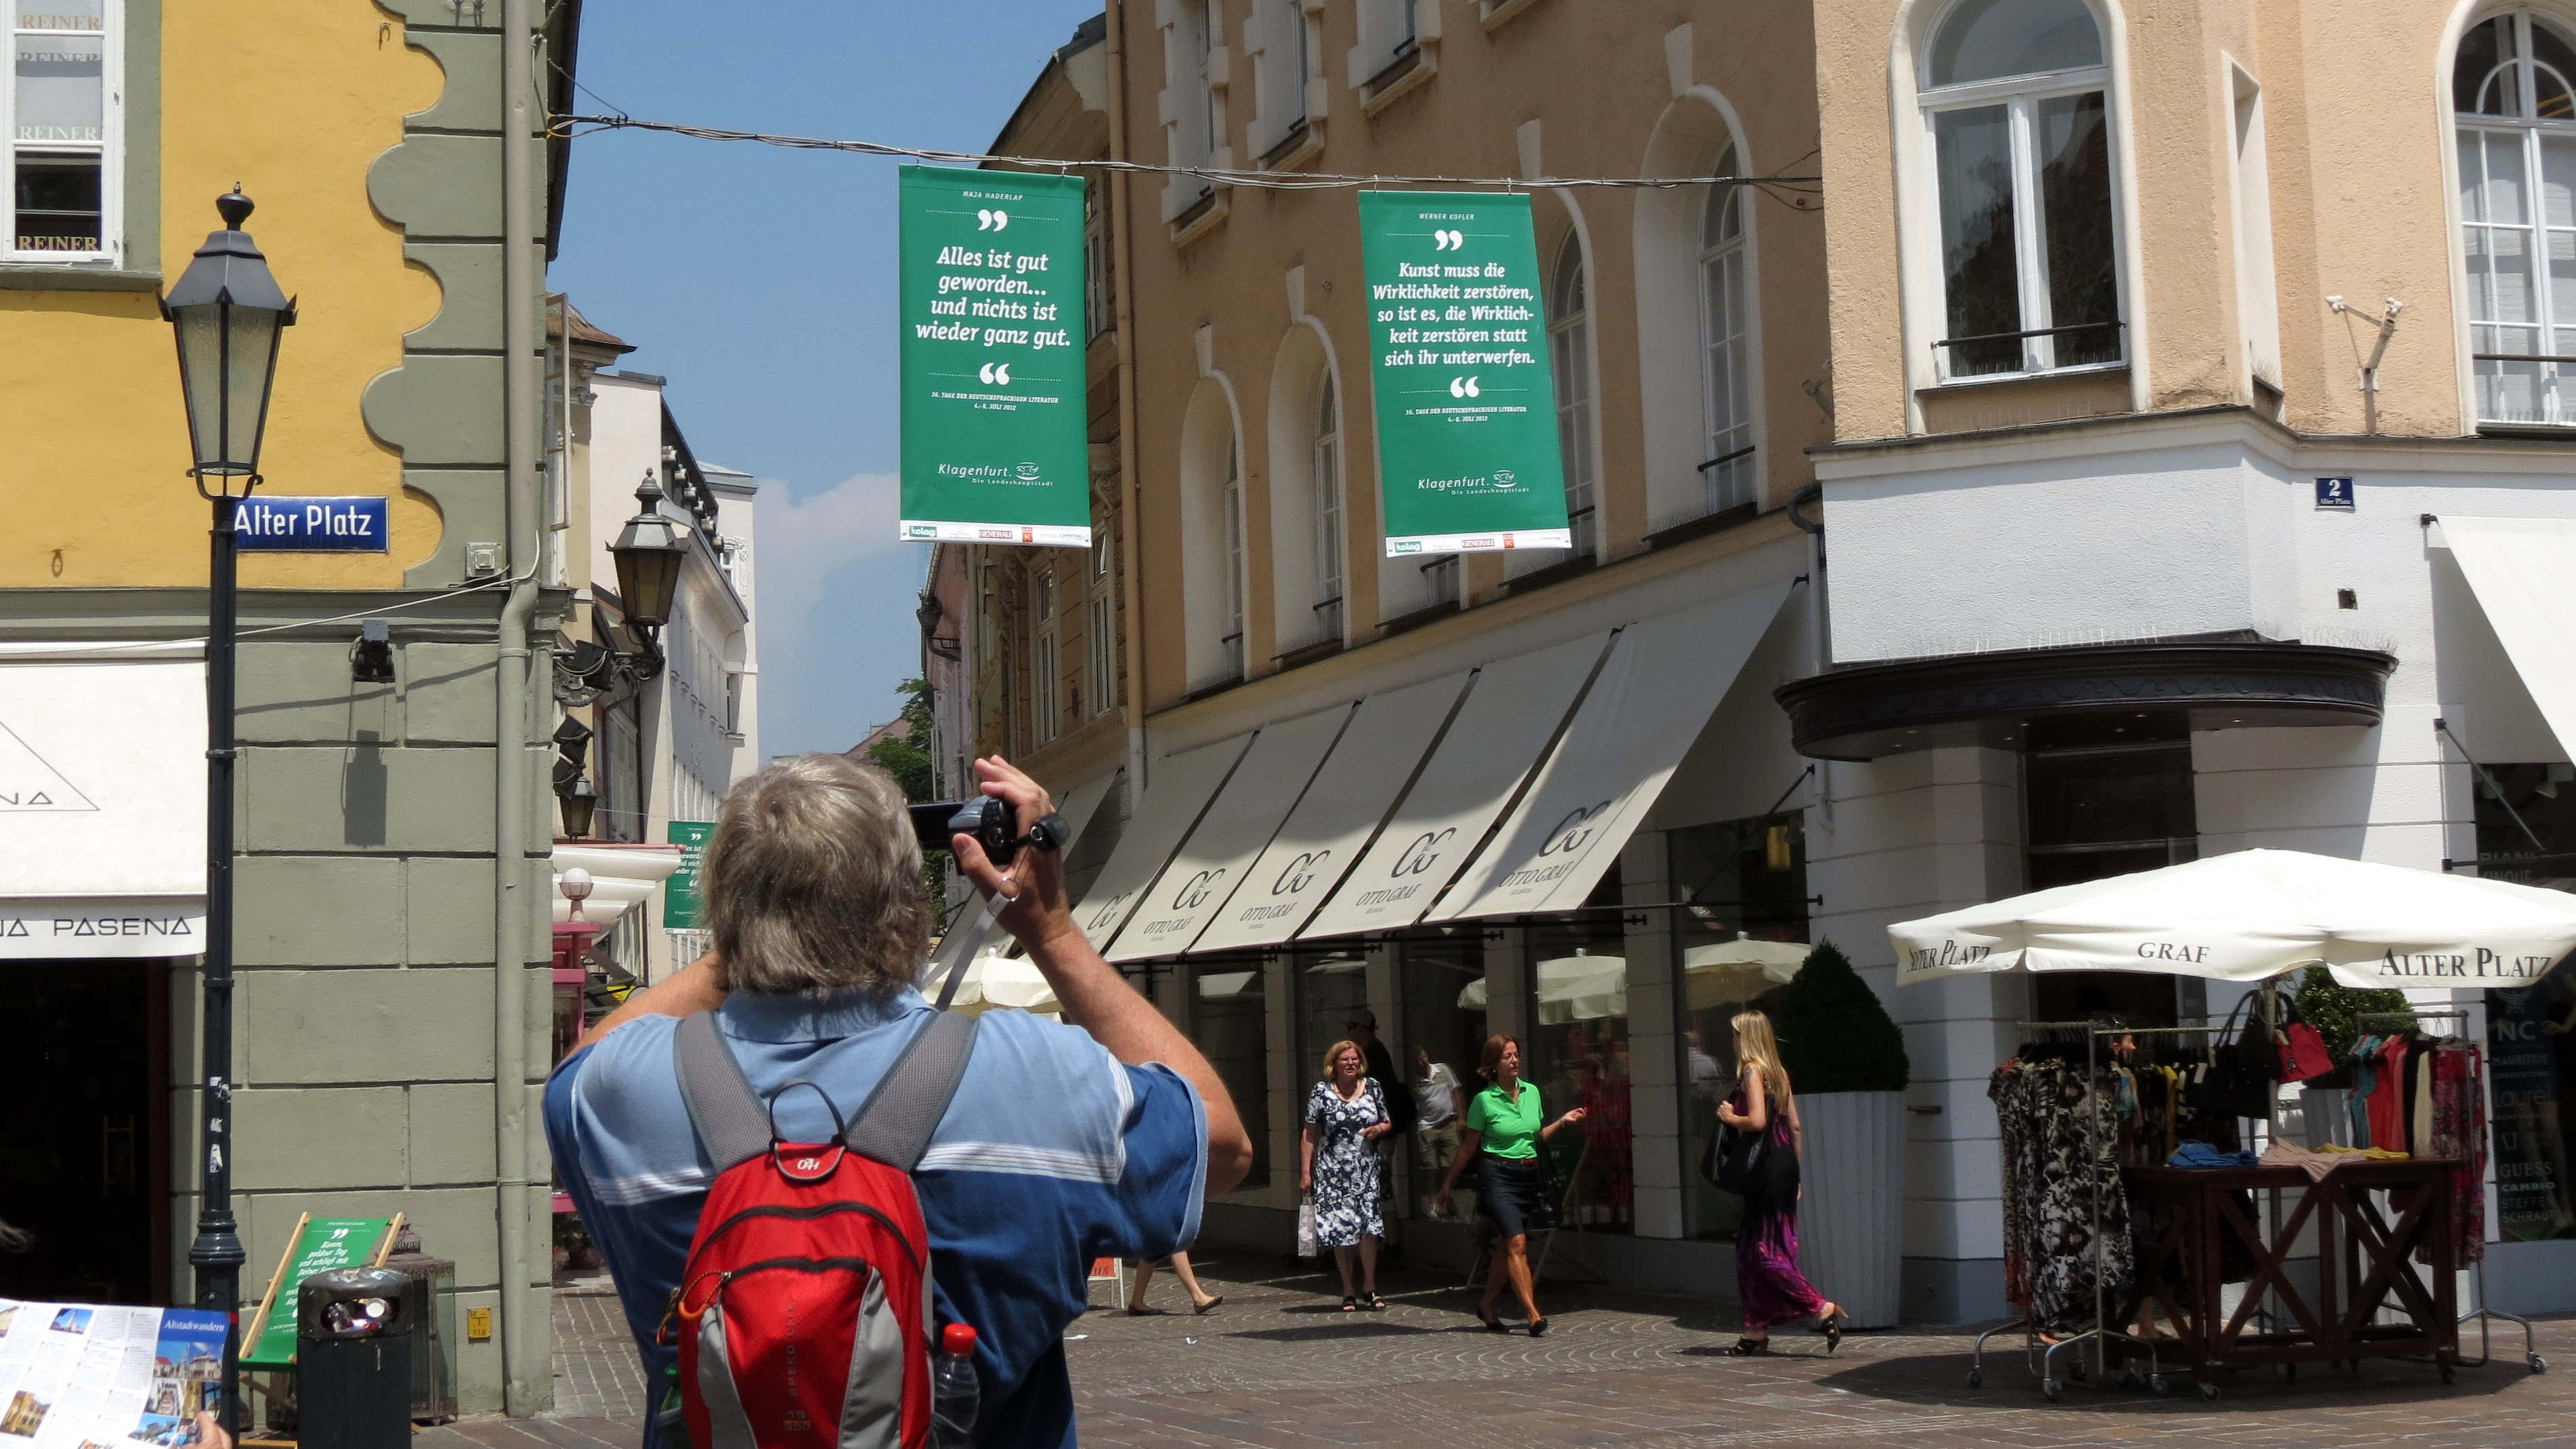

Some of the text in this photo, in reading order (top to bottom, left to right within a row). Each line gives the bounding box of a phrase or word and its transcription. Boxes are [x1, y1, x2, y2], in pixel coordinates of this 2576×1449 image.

[22, 14, 101, 30] REINER
[20, 125, 97, 140] REINER
[963, 190, 1023, 201] MAJA HADERLAP
[18, 236, 99, 250] REINER
[936, 246, 1049, 274] Alles ist gut
[1399, 263, 1505, 278] Kunst muss die
[938, 275, 1046, 295] geworden...
[1373, 284, 1534, 301] Wirklichkeit zerstören,
[931, 297, 1057, 321] und nichts ist
[1377, 305, 1534, 323] so ist es, die Wirklich-
[916, 320, 1071, 350] wieder ganz gut.
[1389, 327, 1528, 344] keit zerstören statt
[1384, 349, 1535, 367] sich ihr unterwerfen.
[968, 394, 1028, 403] DEUTSCHSPRACHIGEN
[938, 463, 1012, 478] Klagenfurt.
[1418, 476, 1490, 491] Klagenfurt.
[2328, 479, 2341, 497] 2
[234, 505, 371, 535] Alter Platz
[911, 527, 935, 537] kelag
[979, 531, 1012, 539] GENERALI
[1396, 542, 1421, 552] kelag
[1462, 539, 1494, 548] GENERALI
[1499, 861, 1575, 888] OTTO GRAF
[1356, 883, 1422, 906] OTTO GRAF
[1240, 902, 1299, 921] OTTO GRAF
[54, 916, 192, 936] PASENA
[1143, 916, 1195, 935] OTTO GRAF
[2137, 942, 2209, 963] GRAF
[2496, 1021, 2536, 1042] NC
[2492, 1054, 2547, 1067] MAURITIUS
[2500, 1162, 2552, 1178] GUESS
[2500, 1182, 2556, 1192] CAMBIO
[335, 1249, 348, 1257] Tag
[165, 1320, 224, 1332] Altstadtwandern
